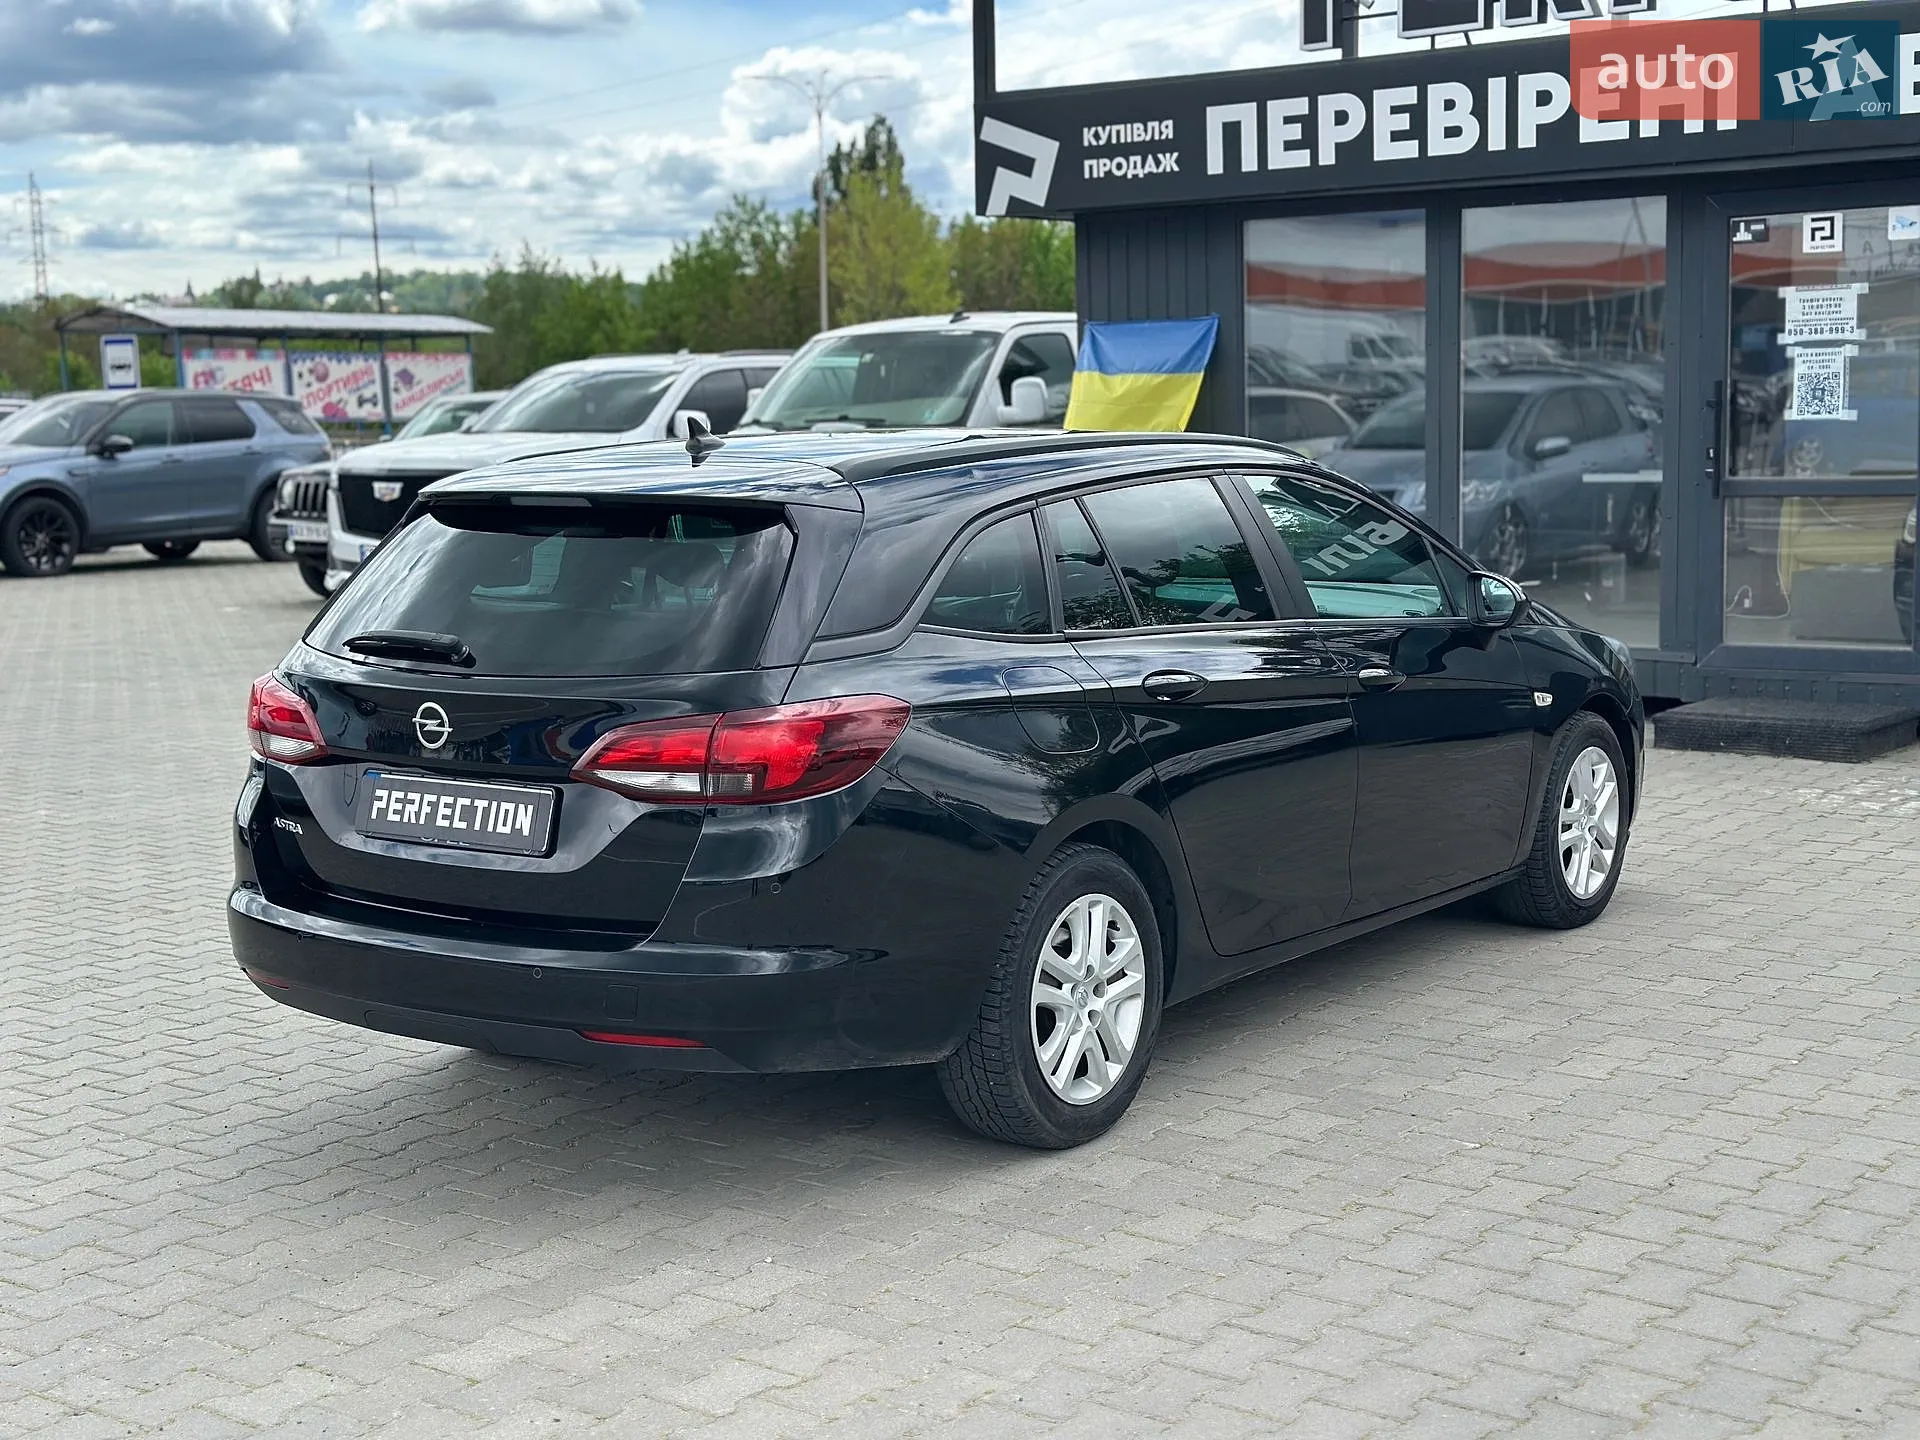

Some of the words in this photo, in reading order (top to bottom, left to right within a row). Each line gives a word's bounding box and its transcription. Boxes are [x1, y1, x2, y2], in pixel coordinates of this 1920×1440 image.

[1083, 119, 1174, 147] КУПІВЛЯ
[1083, 152, 1180, 179] ПРОДАЖ
[273, 816, 304, 835] ASTRA
[370, 788, 534, 837] PERFECTION
